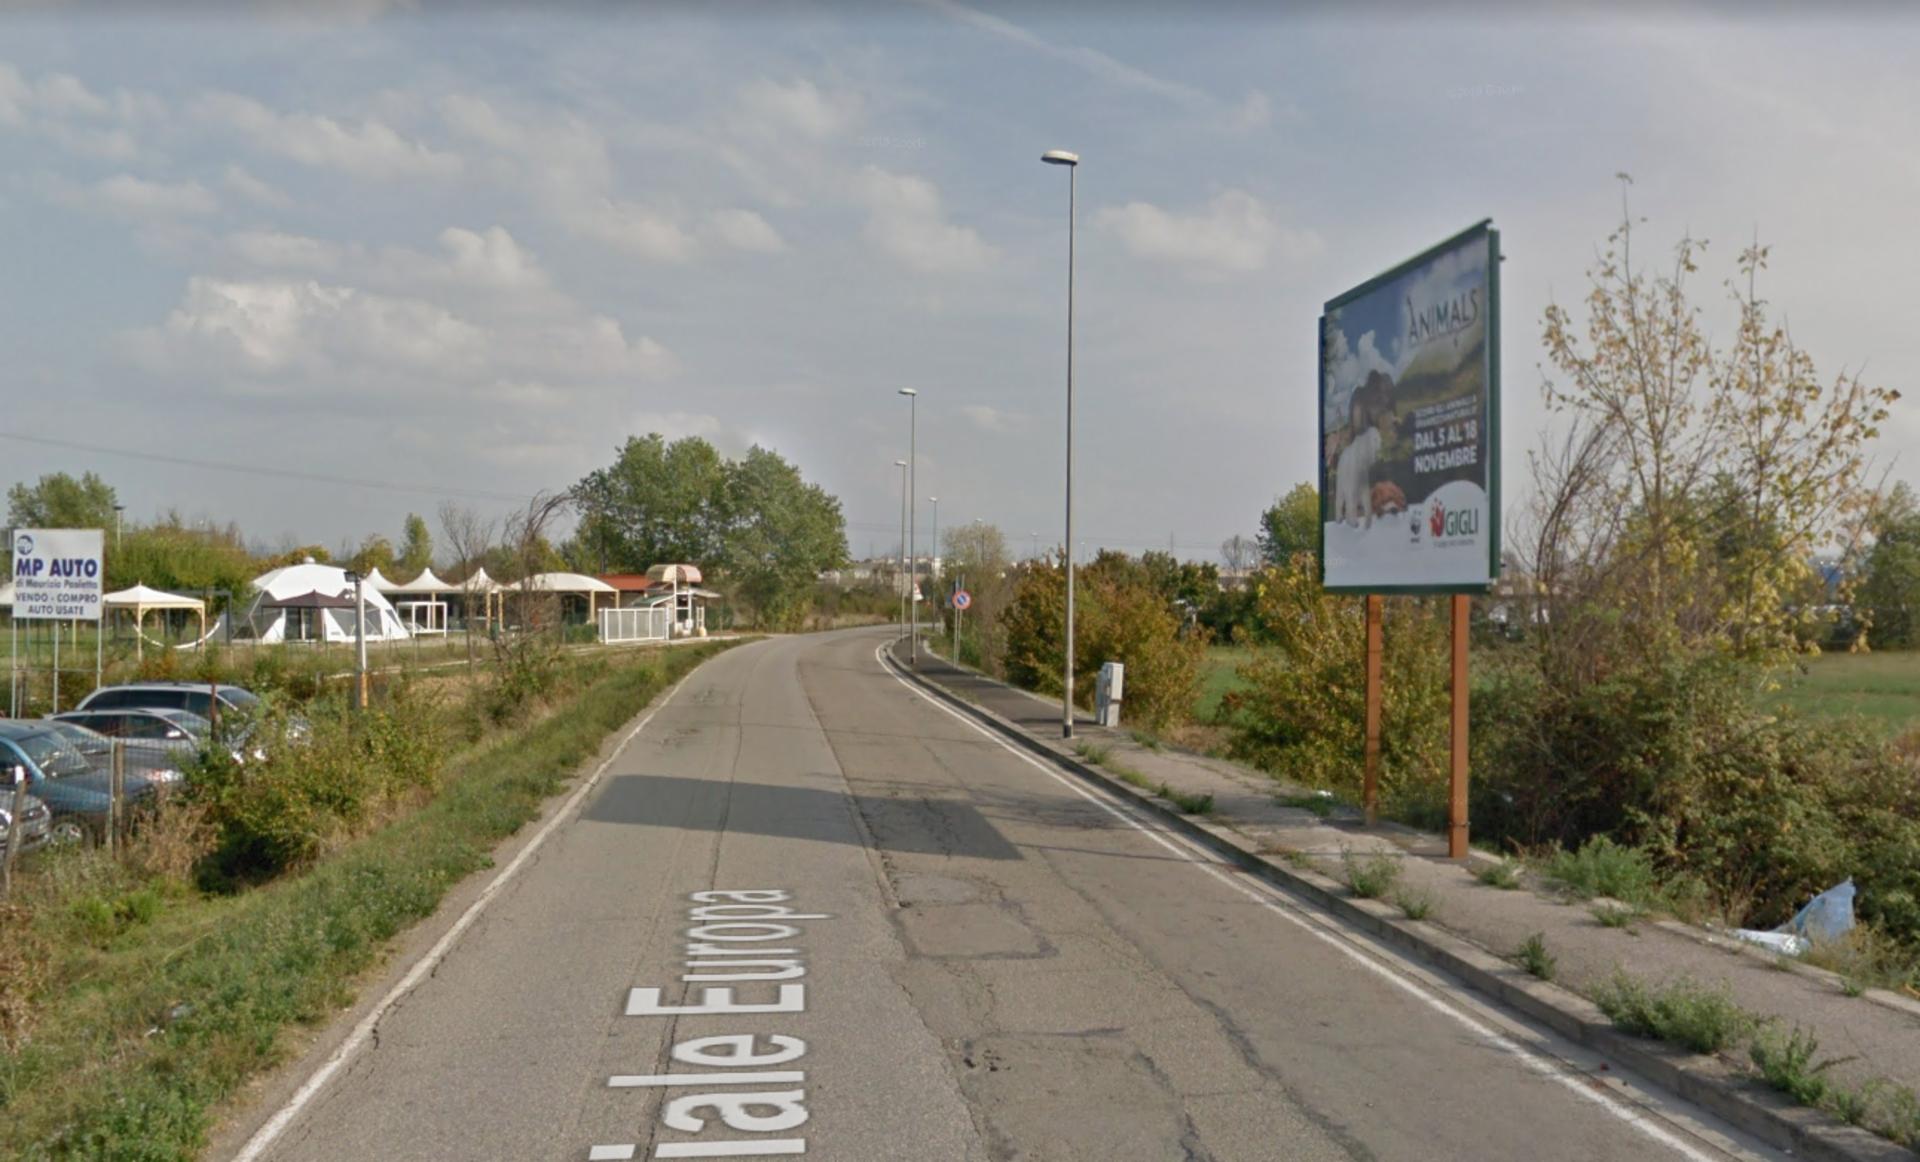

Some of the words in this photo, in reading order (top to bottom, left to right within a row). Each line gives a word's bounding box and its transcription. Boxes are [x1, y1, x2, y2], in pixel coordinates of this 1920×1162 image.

[1406, 288, 1478, 342] ANIMALS
[1414, 430, 1437, 451] DAL
[1438, 426, 1446, 447] 5
[1447, 422, 1464, 445] AL
[1465, 419, 1477, 441] 18
[1414, 445, 1477, 473] NOVEMBRE
[1446, 508, 1478, 536] GIGLI
[16, 558, 43, 576] MP
[49, 558, 97, 577] AUTO
[16, 593, 48, 602] VENDO
[57, 593, 97, 603] COMPRO
[28, 605, 53, 614] AUTO
[55, 605, 84, 616] USATE
[625, 889, 834, 1016] Europa
[589, 1033, 809, 1161] iale
